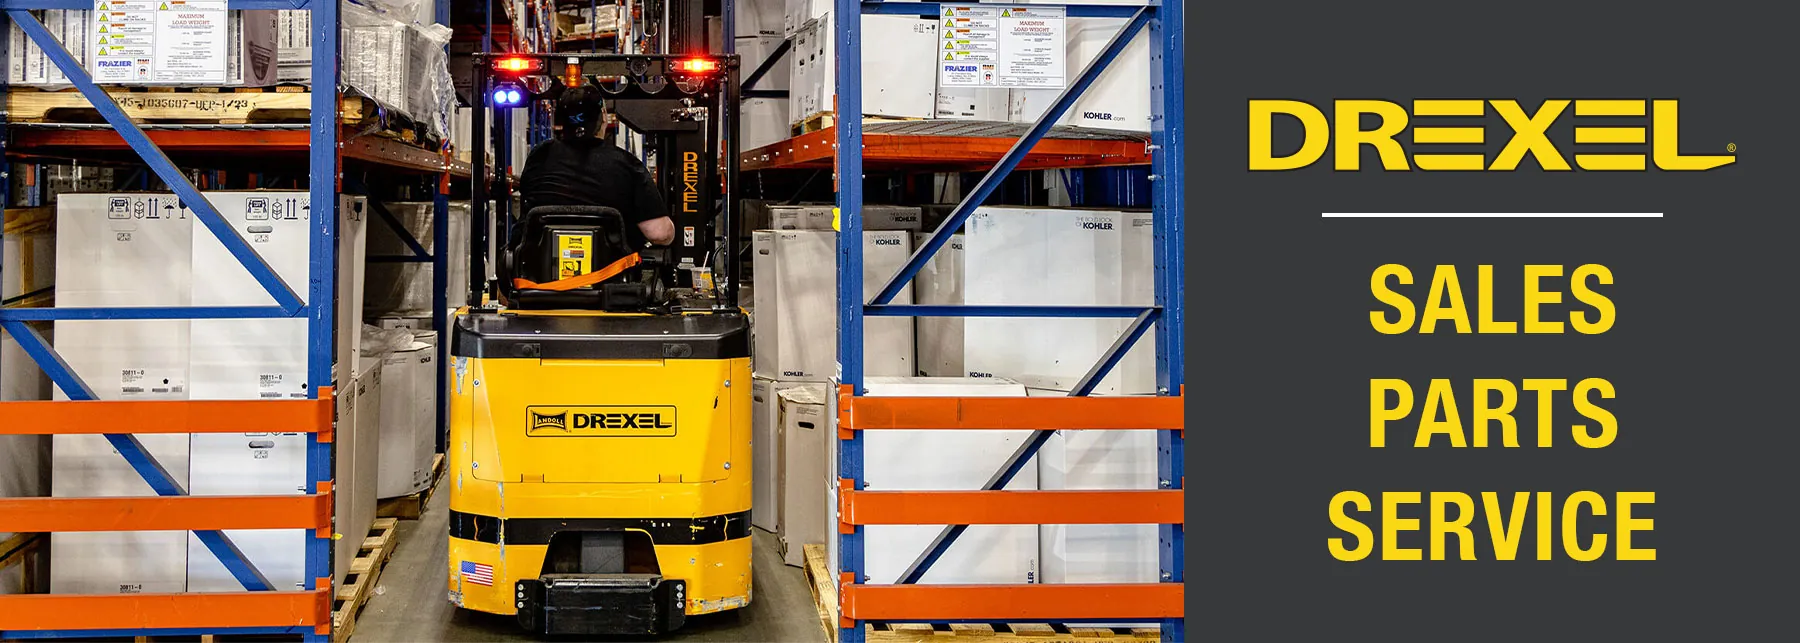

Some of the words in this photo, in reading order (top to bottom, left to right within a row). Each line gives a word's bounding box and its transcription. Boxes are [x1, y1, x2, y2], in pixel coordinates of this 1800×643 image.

[683, 151, 698, 212] DREXEL
[1083, 222, 1113, 230] KOHLER
[534, 414, 565, 428] LANDOLL
[573, 413, 673, 429] DREXEL
